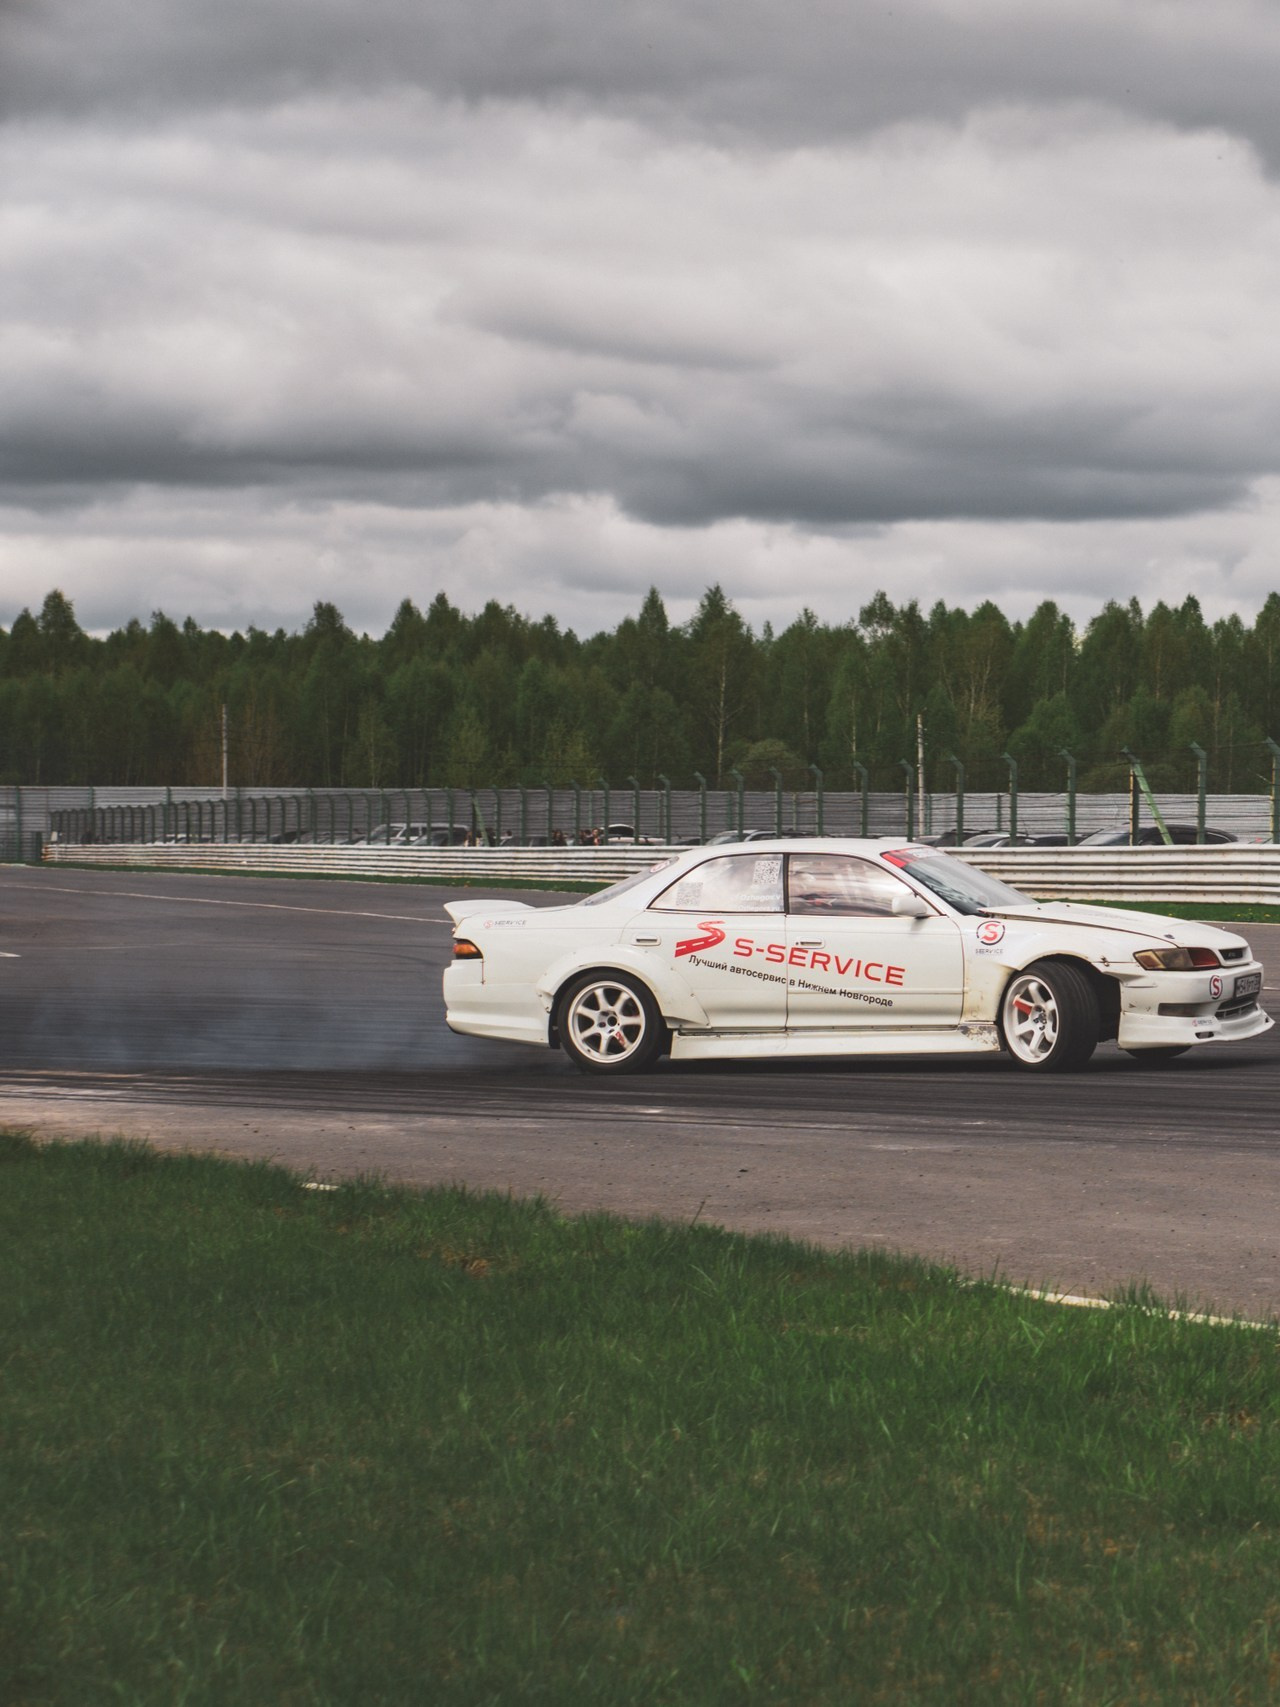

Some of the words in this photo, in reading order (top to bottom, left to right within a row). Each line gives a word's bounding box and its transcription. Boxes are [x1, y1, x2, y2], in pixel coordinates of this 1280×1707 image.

[688, 954, 728, 971] Лучший
[729, 964, 787, 984] автосервис
[797, 979, 837, 995] Нижнем
[839, 988, 893, 1007] Новгороде
[733, 937, 906, 986] S-SERVICE
